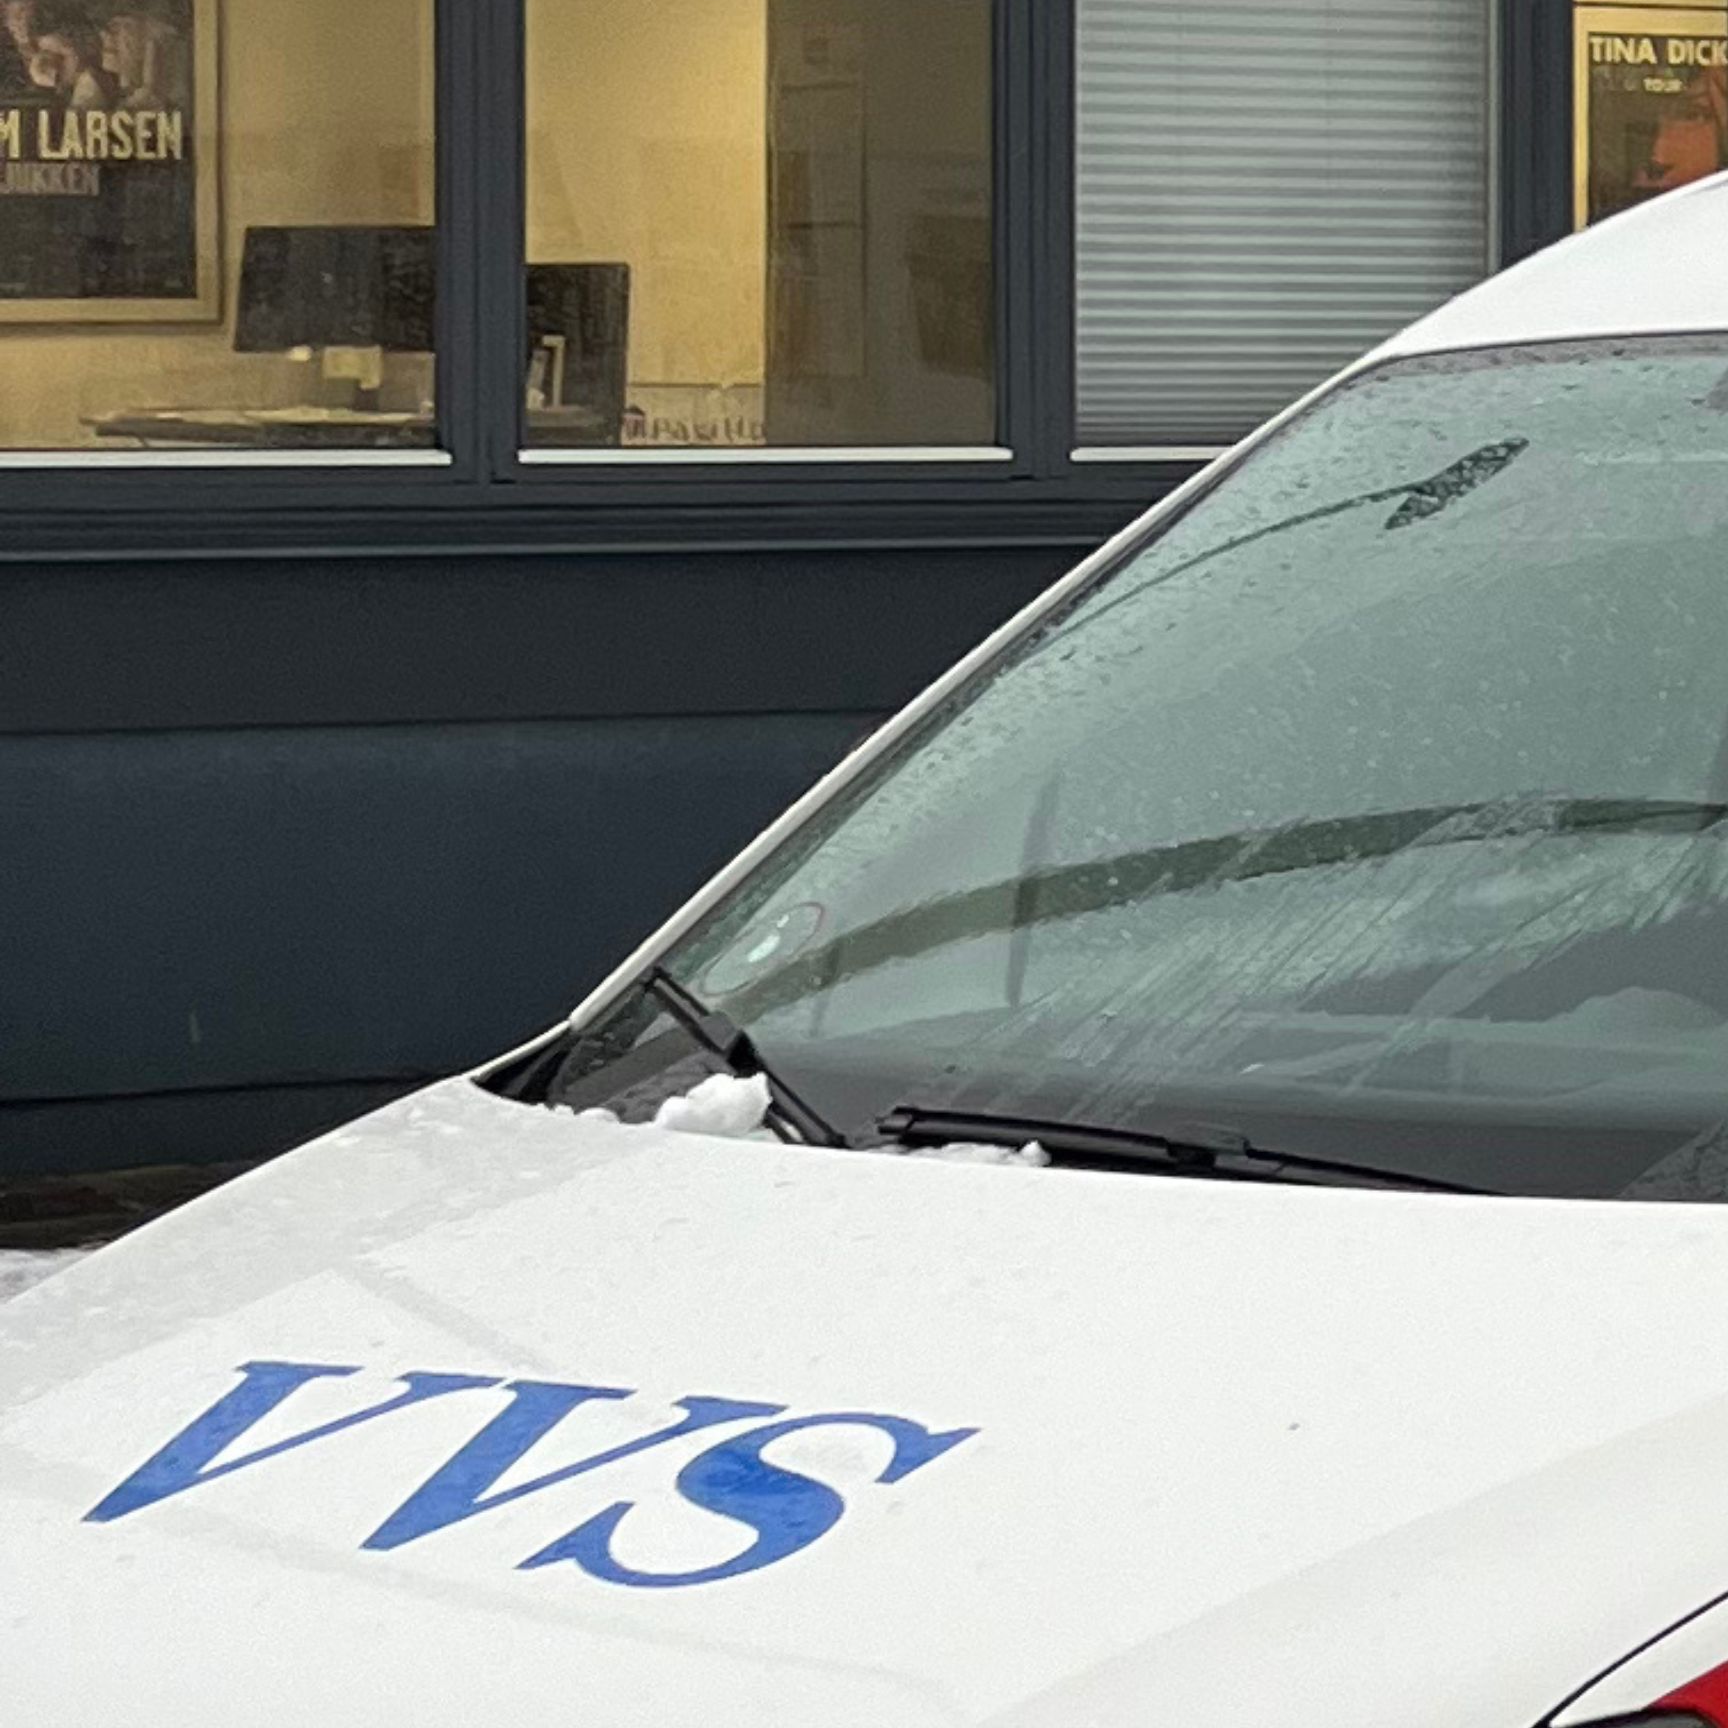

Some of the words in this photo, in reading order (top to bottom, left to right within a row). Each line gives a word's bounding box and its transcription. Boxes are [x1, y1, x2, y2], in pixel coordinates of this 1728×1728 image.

[1590, 37, 1657, 65] TINA
[1667, 39, 1728, 66] DICK
[38, 109, 183, 161] LARSEN
[80, 1360, 982, 1588] VVS
